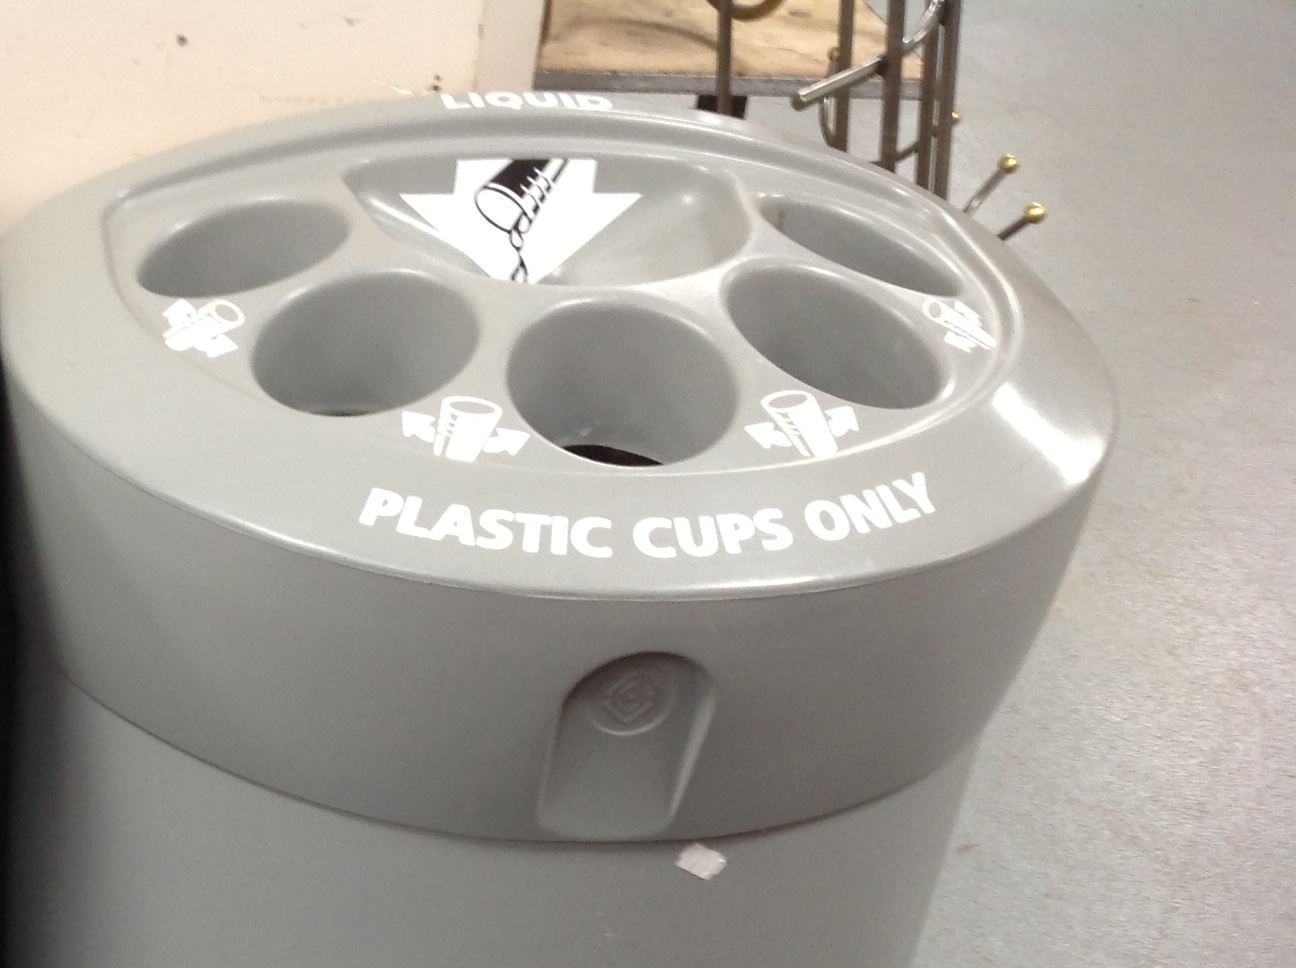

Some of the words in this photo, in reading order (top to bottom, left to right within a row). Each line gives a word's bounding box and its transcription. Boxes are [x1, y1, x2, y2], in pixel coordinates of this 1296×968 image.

[441, 91, 613, 110] LIQUID
[359, 487, 613, 558] PLASTIC
[632, 507, 794, 559] CUPS
[804, 472, 937, 541] ONLY
